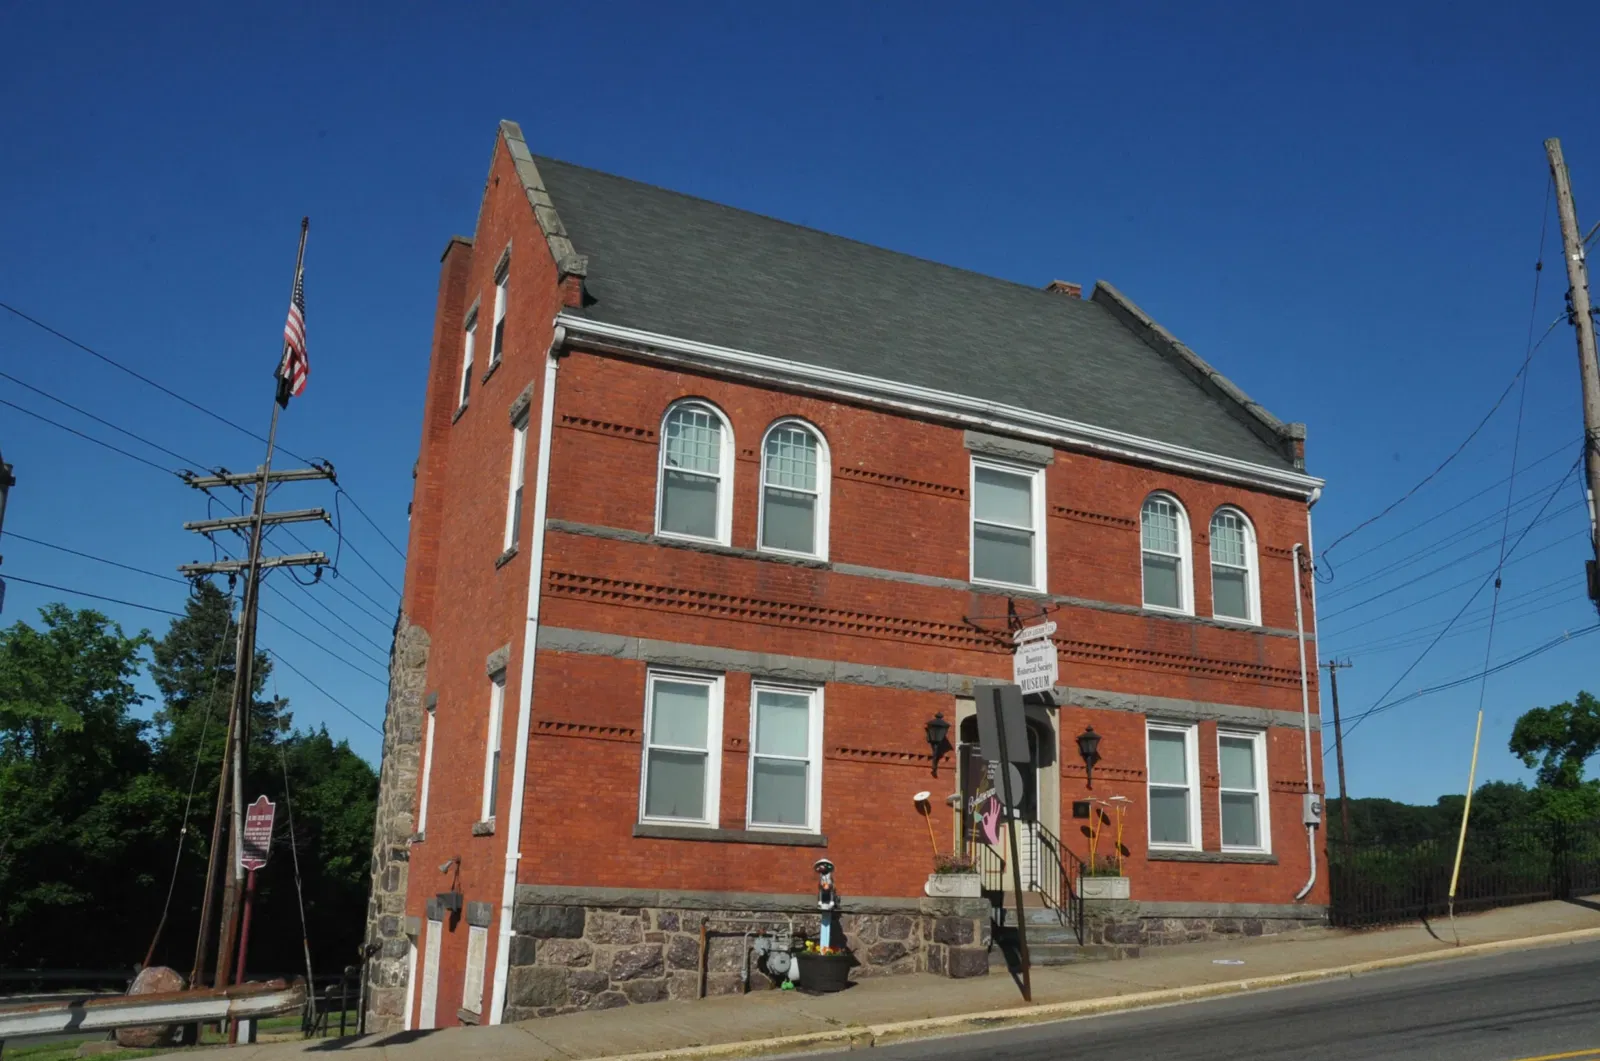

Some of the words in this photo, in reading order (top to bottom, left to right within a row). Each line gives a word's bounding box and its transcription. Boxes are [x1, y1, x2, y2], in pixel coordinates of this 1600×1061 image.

[1017, 664, 1036, 676] Historical
[1037, 662, 1052, 672] Society
[1021, 675, 1049, 691] MUSEUM
